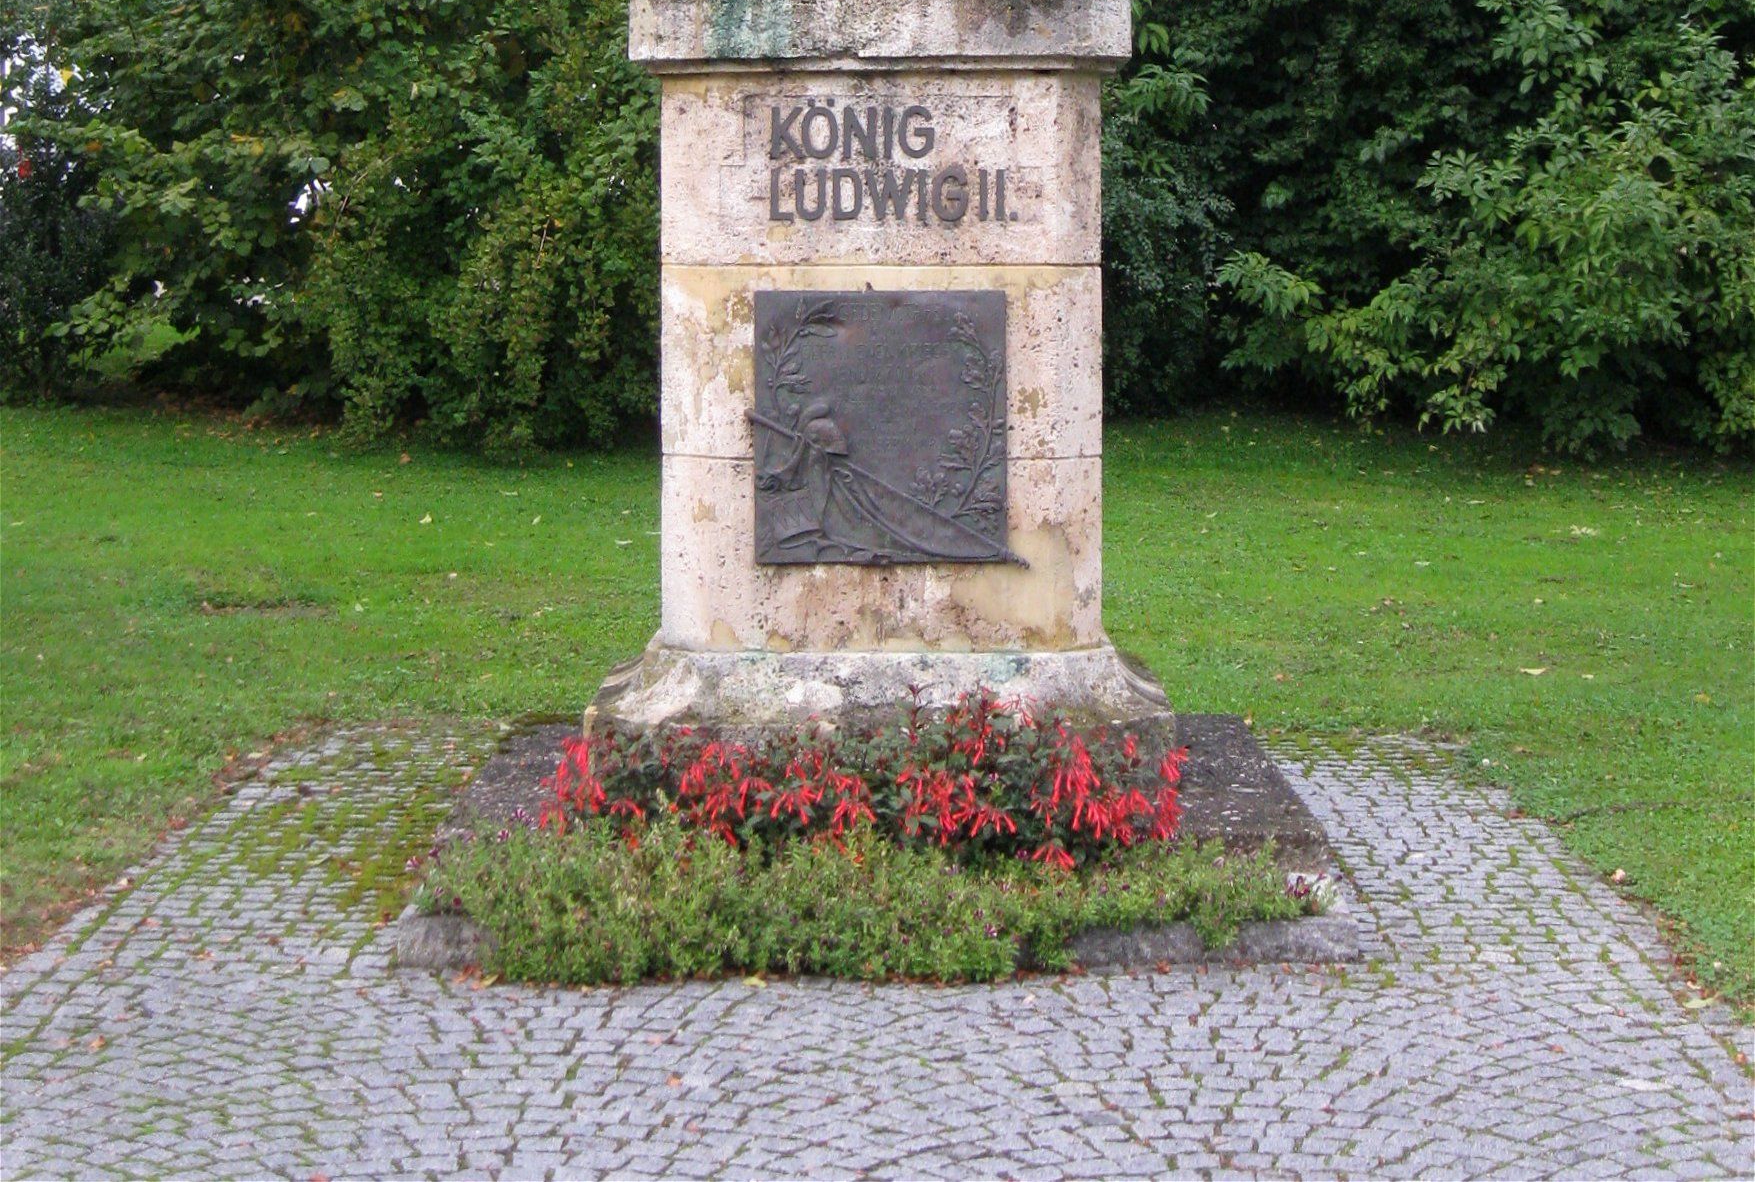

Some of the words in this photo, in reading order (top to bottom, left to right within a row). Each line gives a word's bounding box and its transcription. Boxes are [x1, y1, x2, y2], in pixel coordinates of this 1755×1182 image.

[769, 98, 935, 160] KÖNIG
[769, 169, 970, 222] LUDWIG
[978, 169, 1019, 221] II.
